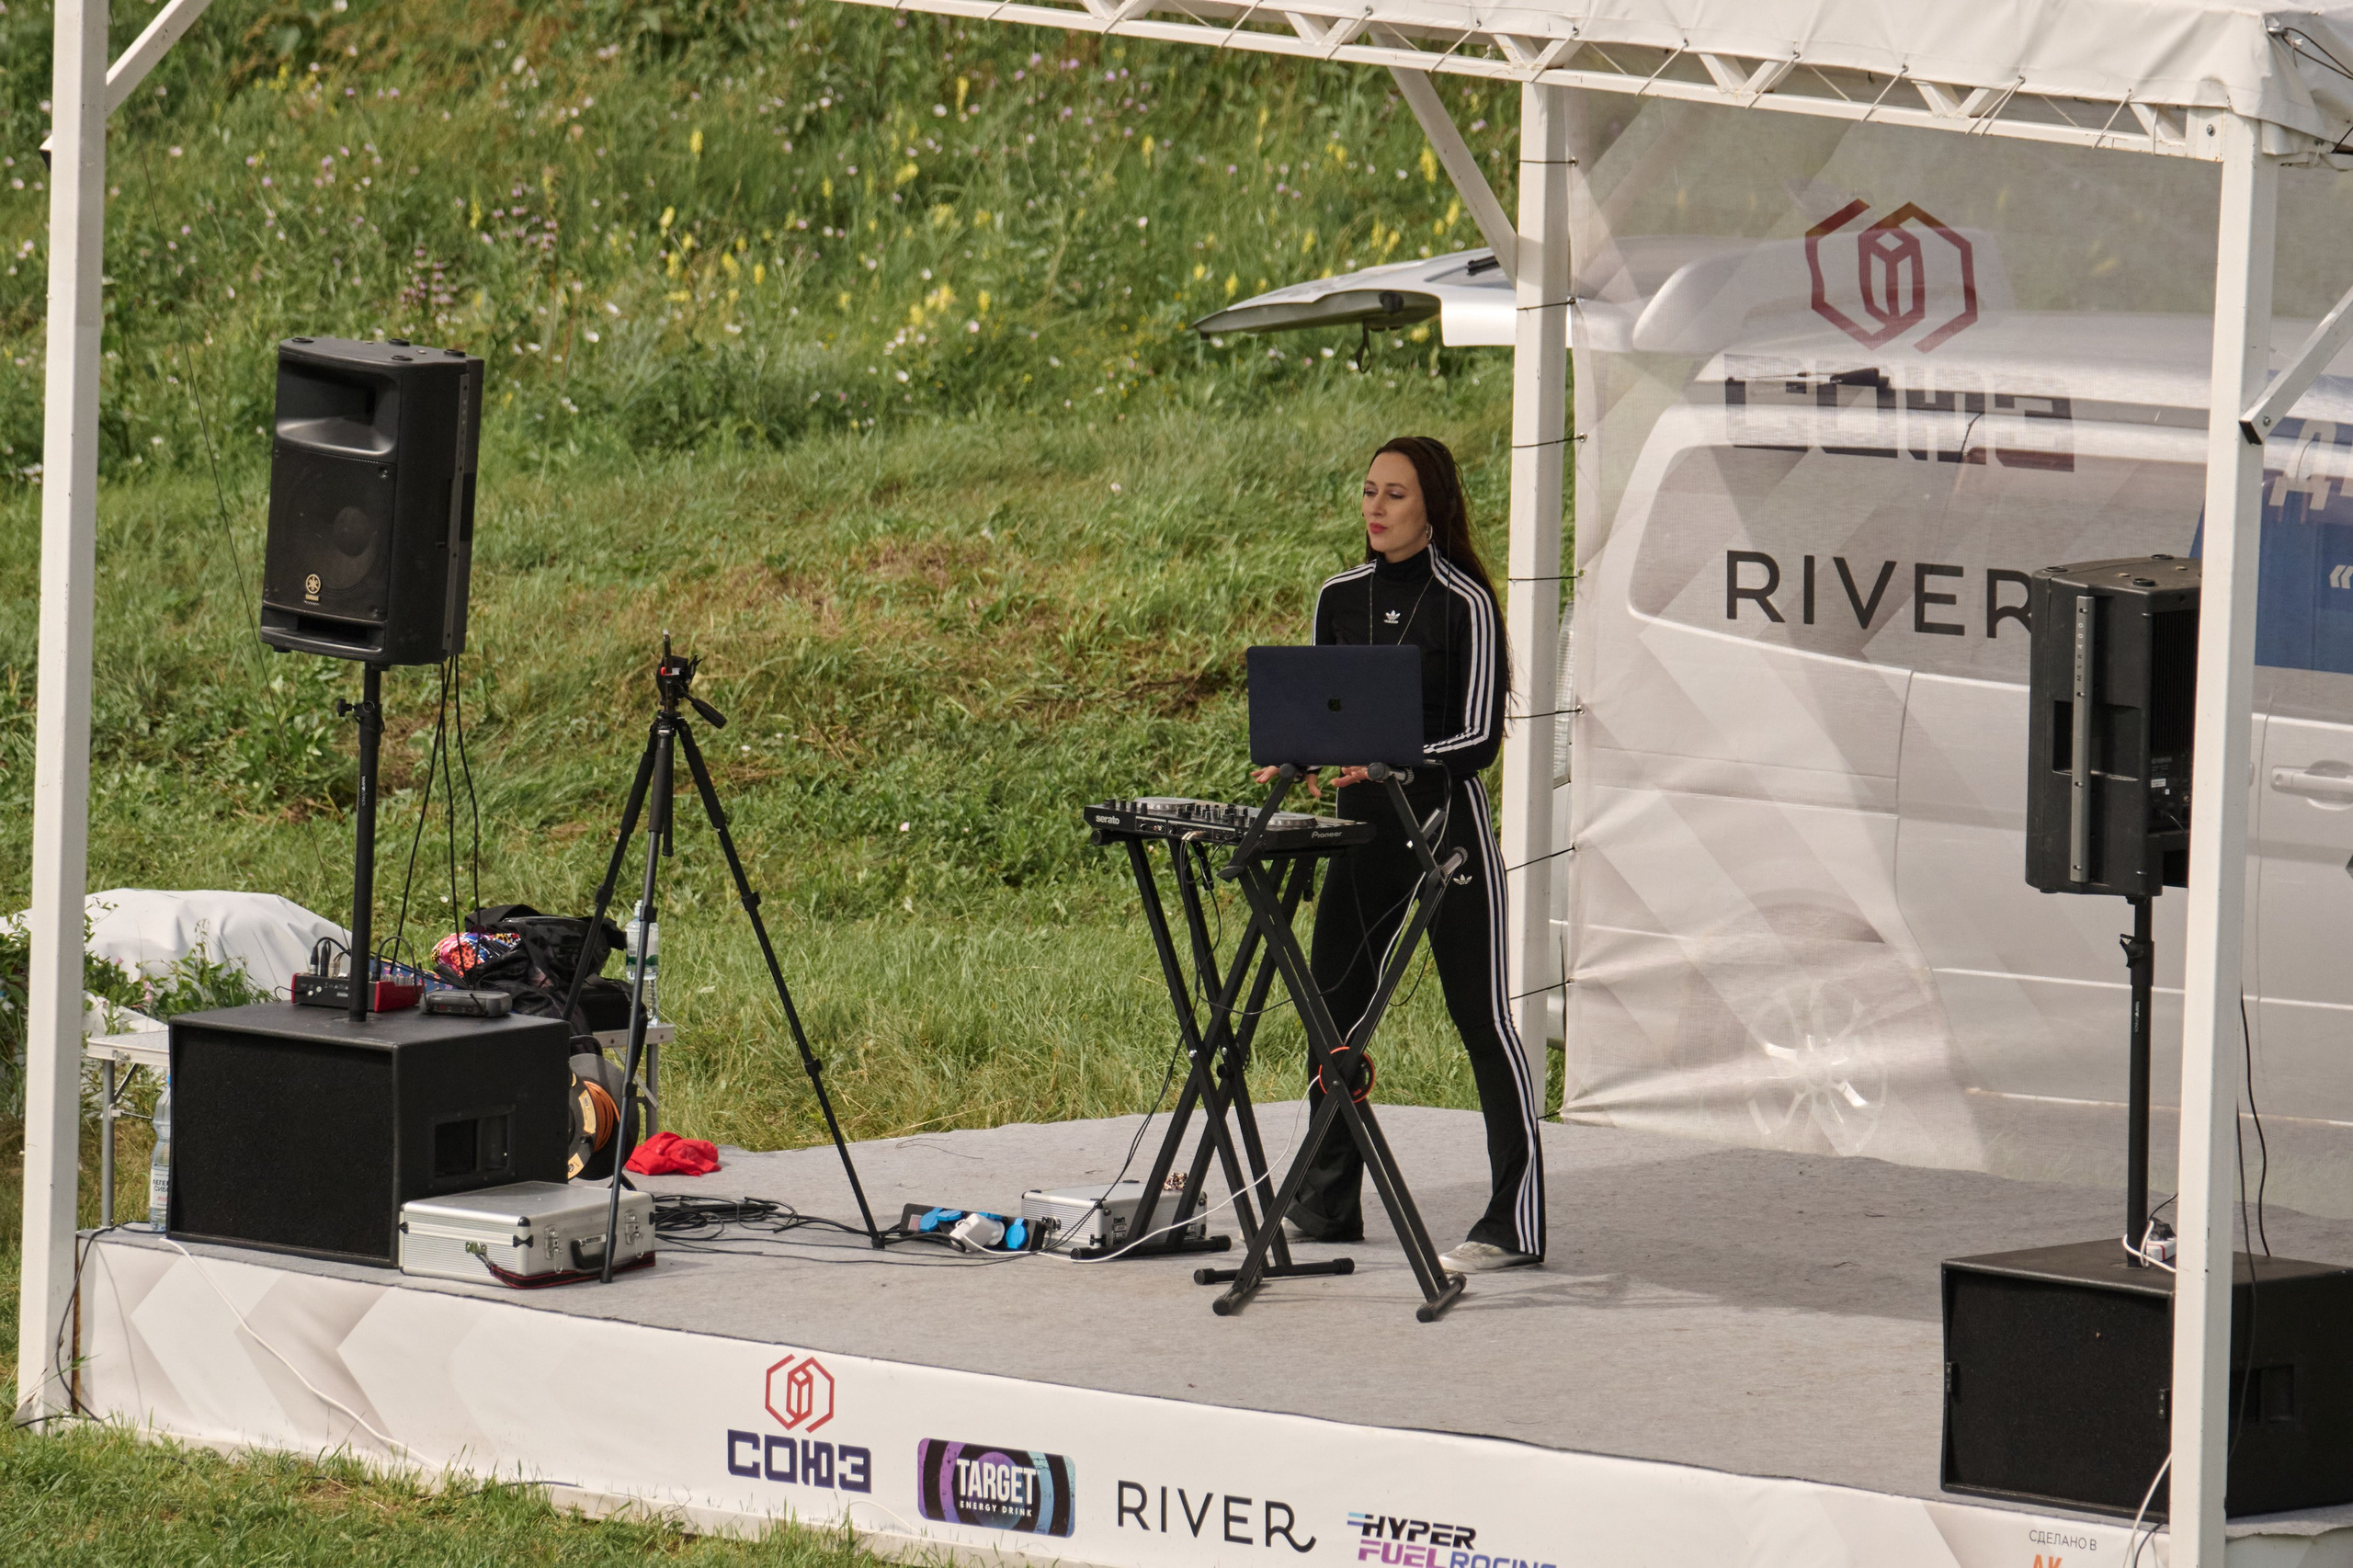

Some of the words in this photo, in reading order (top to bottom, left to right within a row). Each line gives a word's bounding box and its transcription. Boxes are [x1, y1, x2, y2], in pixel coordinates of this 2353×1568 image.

[1726, 550, 2032, 639] RIVER
[1096, 814, 1120, 825] serato
[1311, 831, 1343, 839] Pioneer
[153, 1185, 168, 1193] СИБ
[727, 1428, 872, 1494] СОЮЗ
[956, 1458, 1037, 1505] TARGET
[959, 1500, 997, 1513] ENERGY
[1001, 1505, 1032, 1517] DRINK
[1117, 1479, 1317, 1553] RIVER
[1359, 1513, 1477, 1551] HYPER
[2029, 1529, 2087, 1550] СДЕЛАНО
[2089, 1539, 2097, 1551] В
